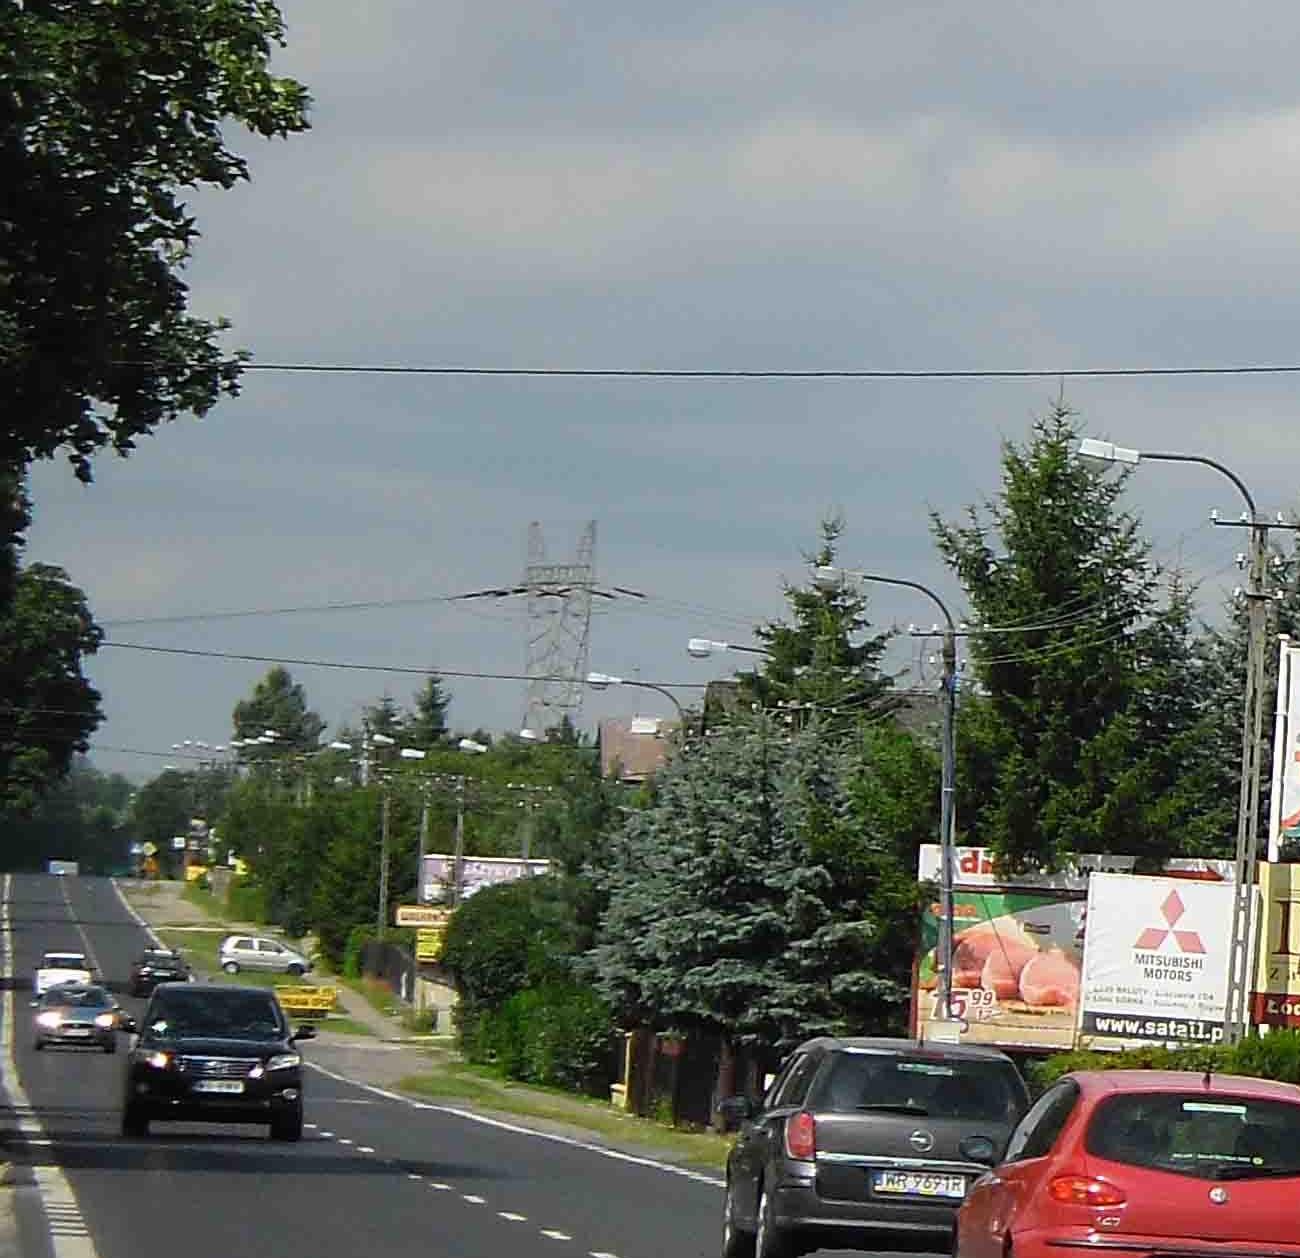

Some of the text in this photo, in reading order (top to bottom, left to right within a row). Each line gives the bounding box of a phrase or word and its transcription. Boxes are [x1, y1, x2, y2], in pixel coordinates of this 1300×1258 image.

[1134, 954, 1203, 969] MITSUBISHI
[1144, 967, 1192, 982] MOTORS
[971, 990, 993, 1006] 99
